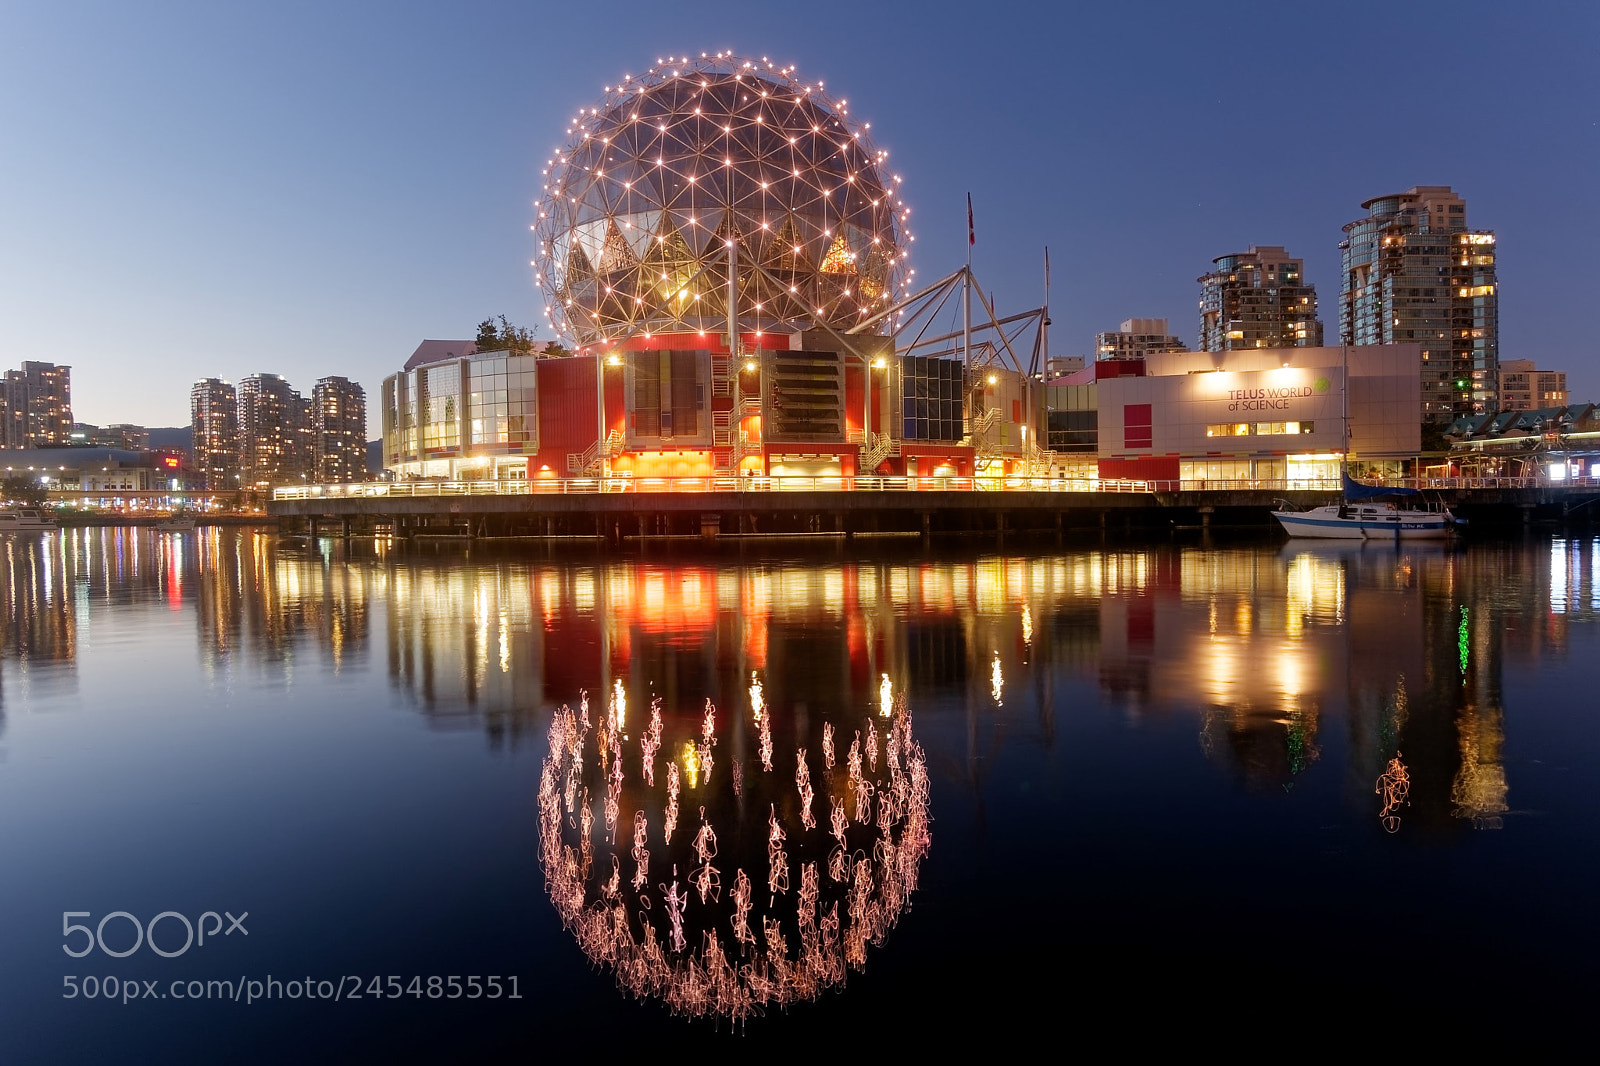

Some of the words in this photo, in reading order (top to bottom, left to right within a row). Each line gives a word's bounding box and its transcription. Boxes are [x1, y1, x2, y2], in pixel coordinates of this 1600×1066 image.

[1228, 389, 1265, 401] TELUS
[1267, 386, 1312, 399] WORLD
[1228, 401, 1240, 412] of
[1242, 399, 1290, 411] SCIENCE
